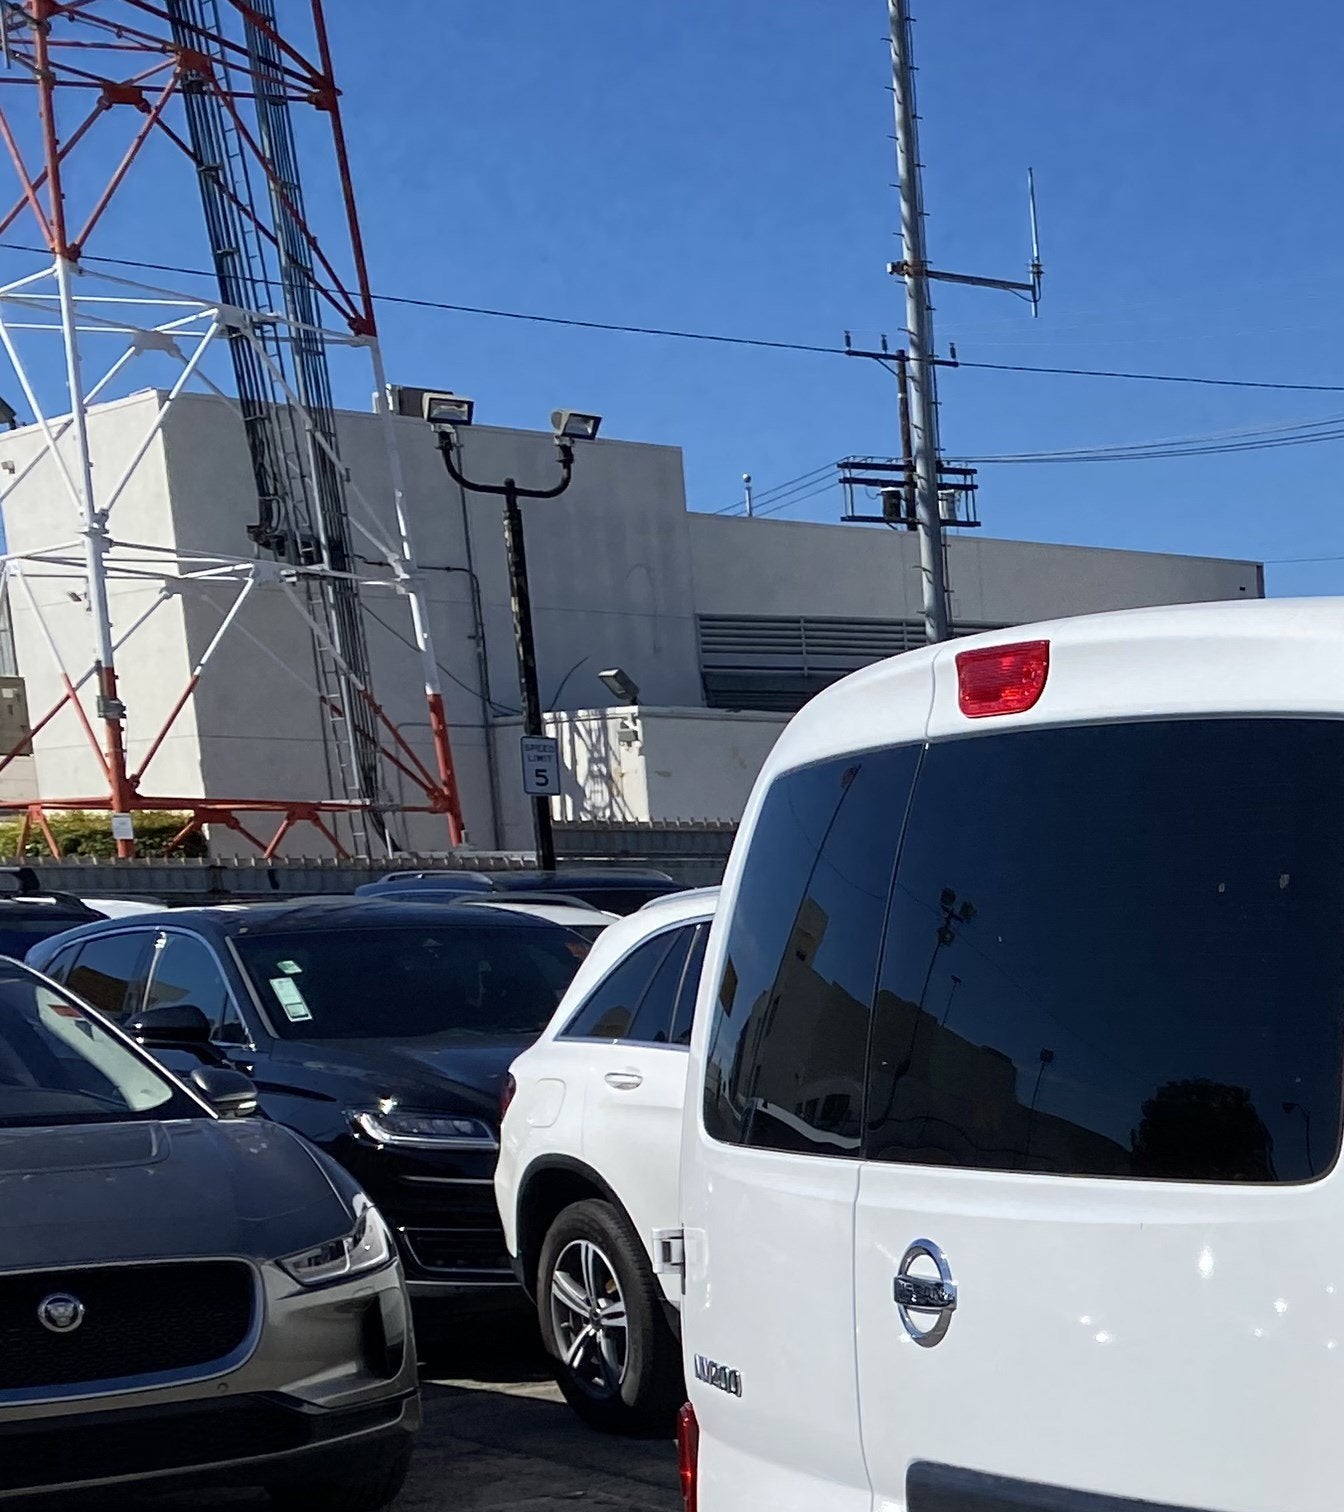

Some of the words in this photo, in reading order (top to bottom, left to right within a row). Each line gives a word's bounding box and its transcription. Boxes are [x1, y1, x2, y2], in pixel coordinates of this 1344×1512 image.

[524, 744, 554, 753] SPEED
[528, 754, 552, 763] LIMIT
[535, 769, 549, 787] 5
